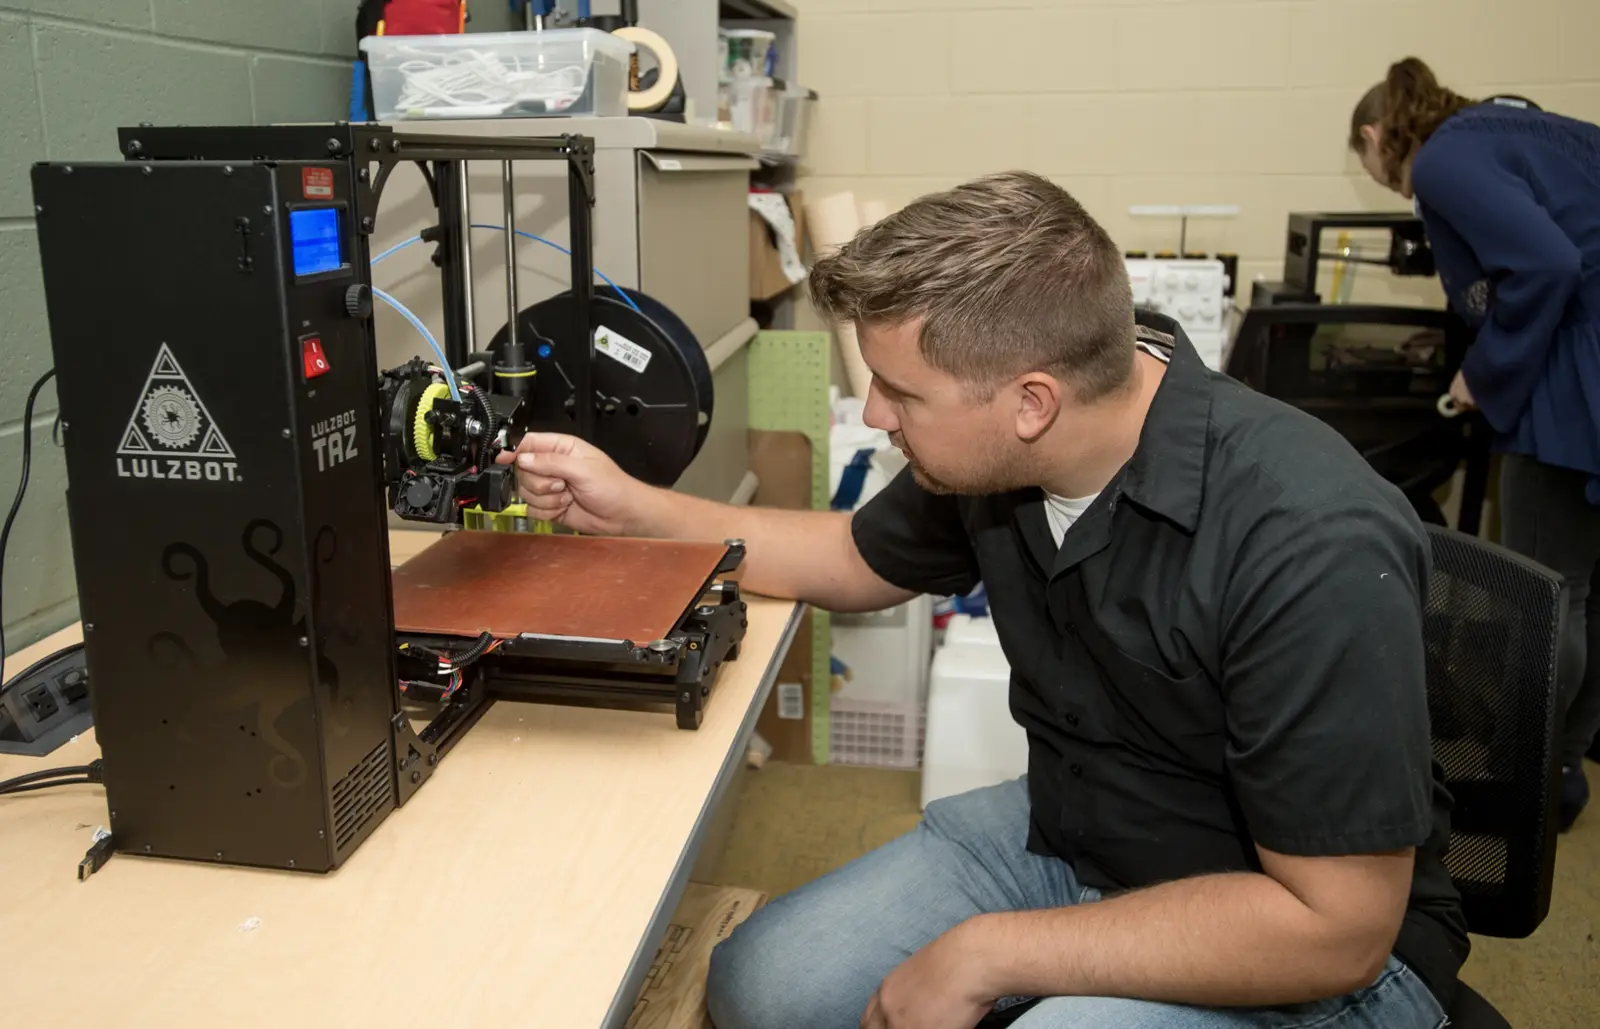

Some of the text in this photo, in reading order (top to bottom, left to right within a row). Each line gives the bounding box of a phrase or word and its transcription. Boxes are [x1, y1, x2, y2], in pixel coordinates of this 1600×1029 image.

[310, 409, 356, 438] LULZBOT
[312, 424, 358, 472] TAZ
[116, 458, 238, 481] LULZBOT
